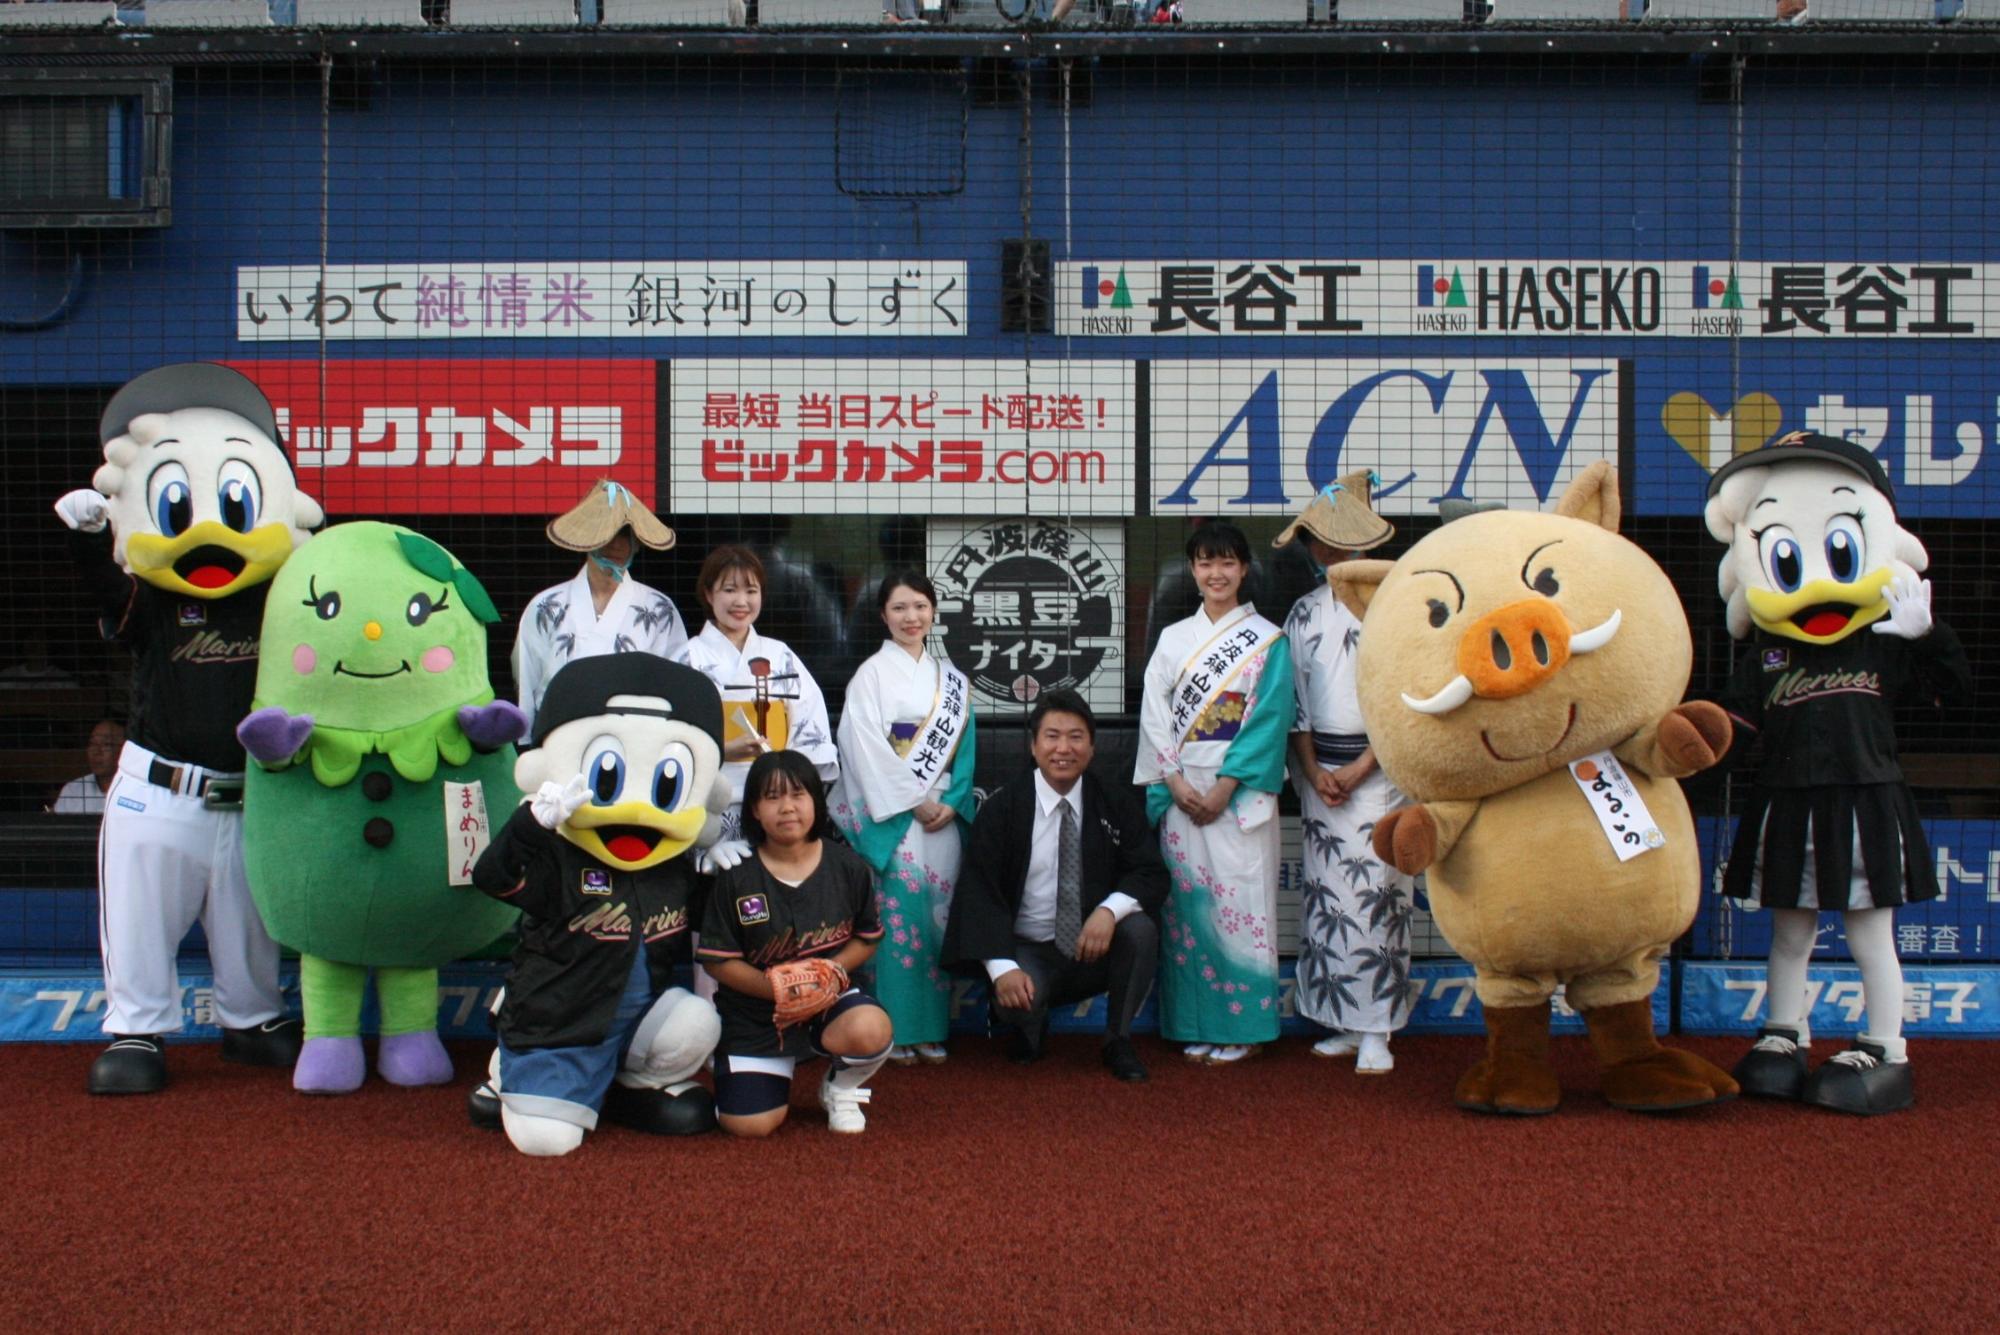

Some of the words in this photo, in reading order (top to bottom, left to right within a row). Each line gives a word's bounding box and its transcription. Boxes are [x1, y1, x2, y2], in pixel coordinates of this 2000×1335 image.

[246, 272, 595, 329] いわて純情米
[625, 268, 959, 327] 銀河のしずく
[1148, 264, 1363, 332] 長谷工
[1478, 266, 1661, 332] HASEKO
[1758, 265, 1974, 334] 長谷工
[1081, 315, 1133, 335] HASEKO
[1417, 313, 1468, 332] HASEKO
[1691, 315, 1743, 336] HASEKO
[701, 392, 781, 429] 最短
[276, 406, 622, 467] ックカメラ
[1158, 368, 1613, 505] ACN
[1805, 394, 2000, 485] セレ
[701, 438, 1105, 484] ビックカメラ.com
[945, 521, 1106, 592] 丹波篠山
[972, 591, 1080, 626] 黒豆
[171, 630, 260, 662] Marin
[969, 639, 1082, 671] ナイター
[1763, 667, 1880, 710] Marines
[460, 786, 480, 878] まめりん
[568, 902, 688, 935] Marin
